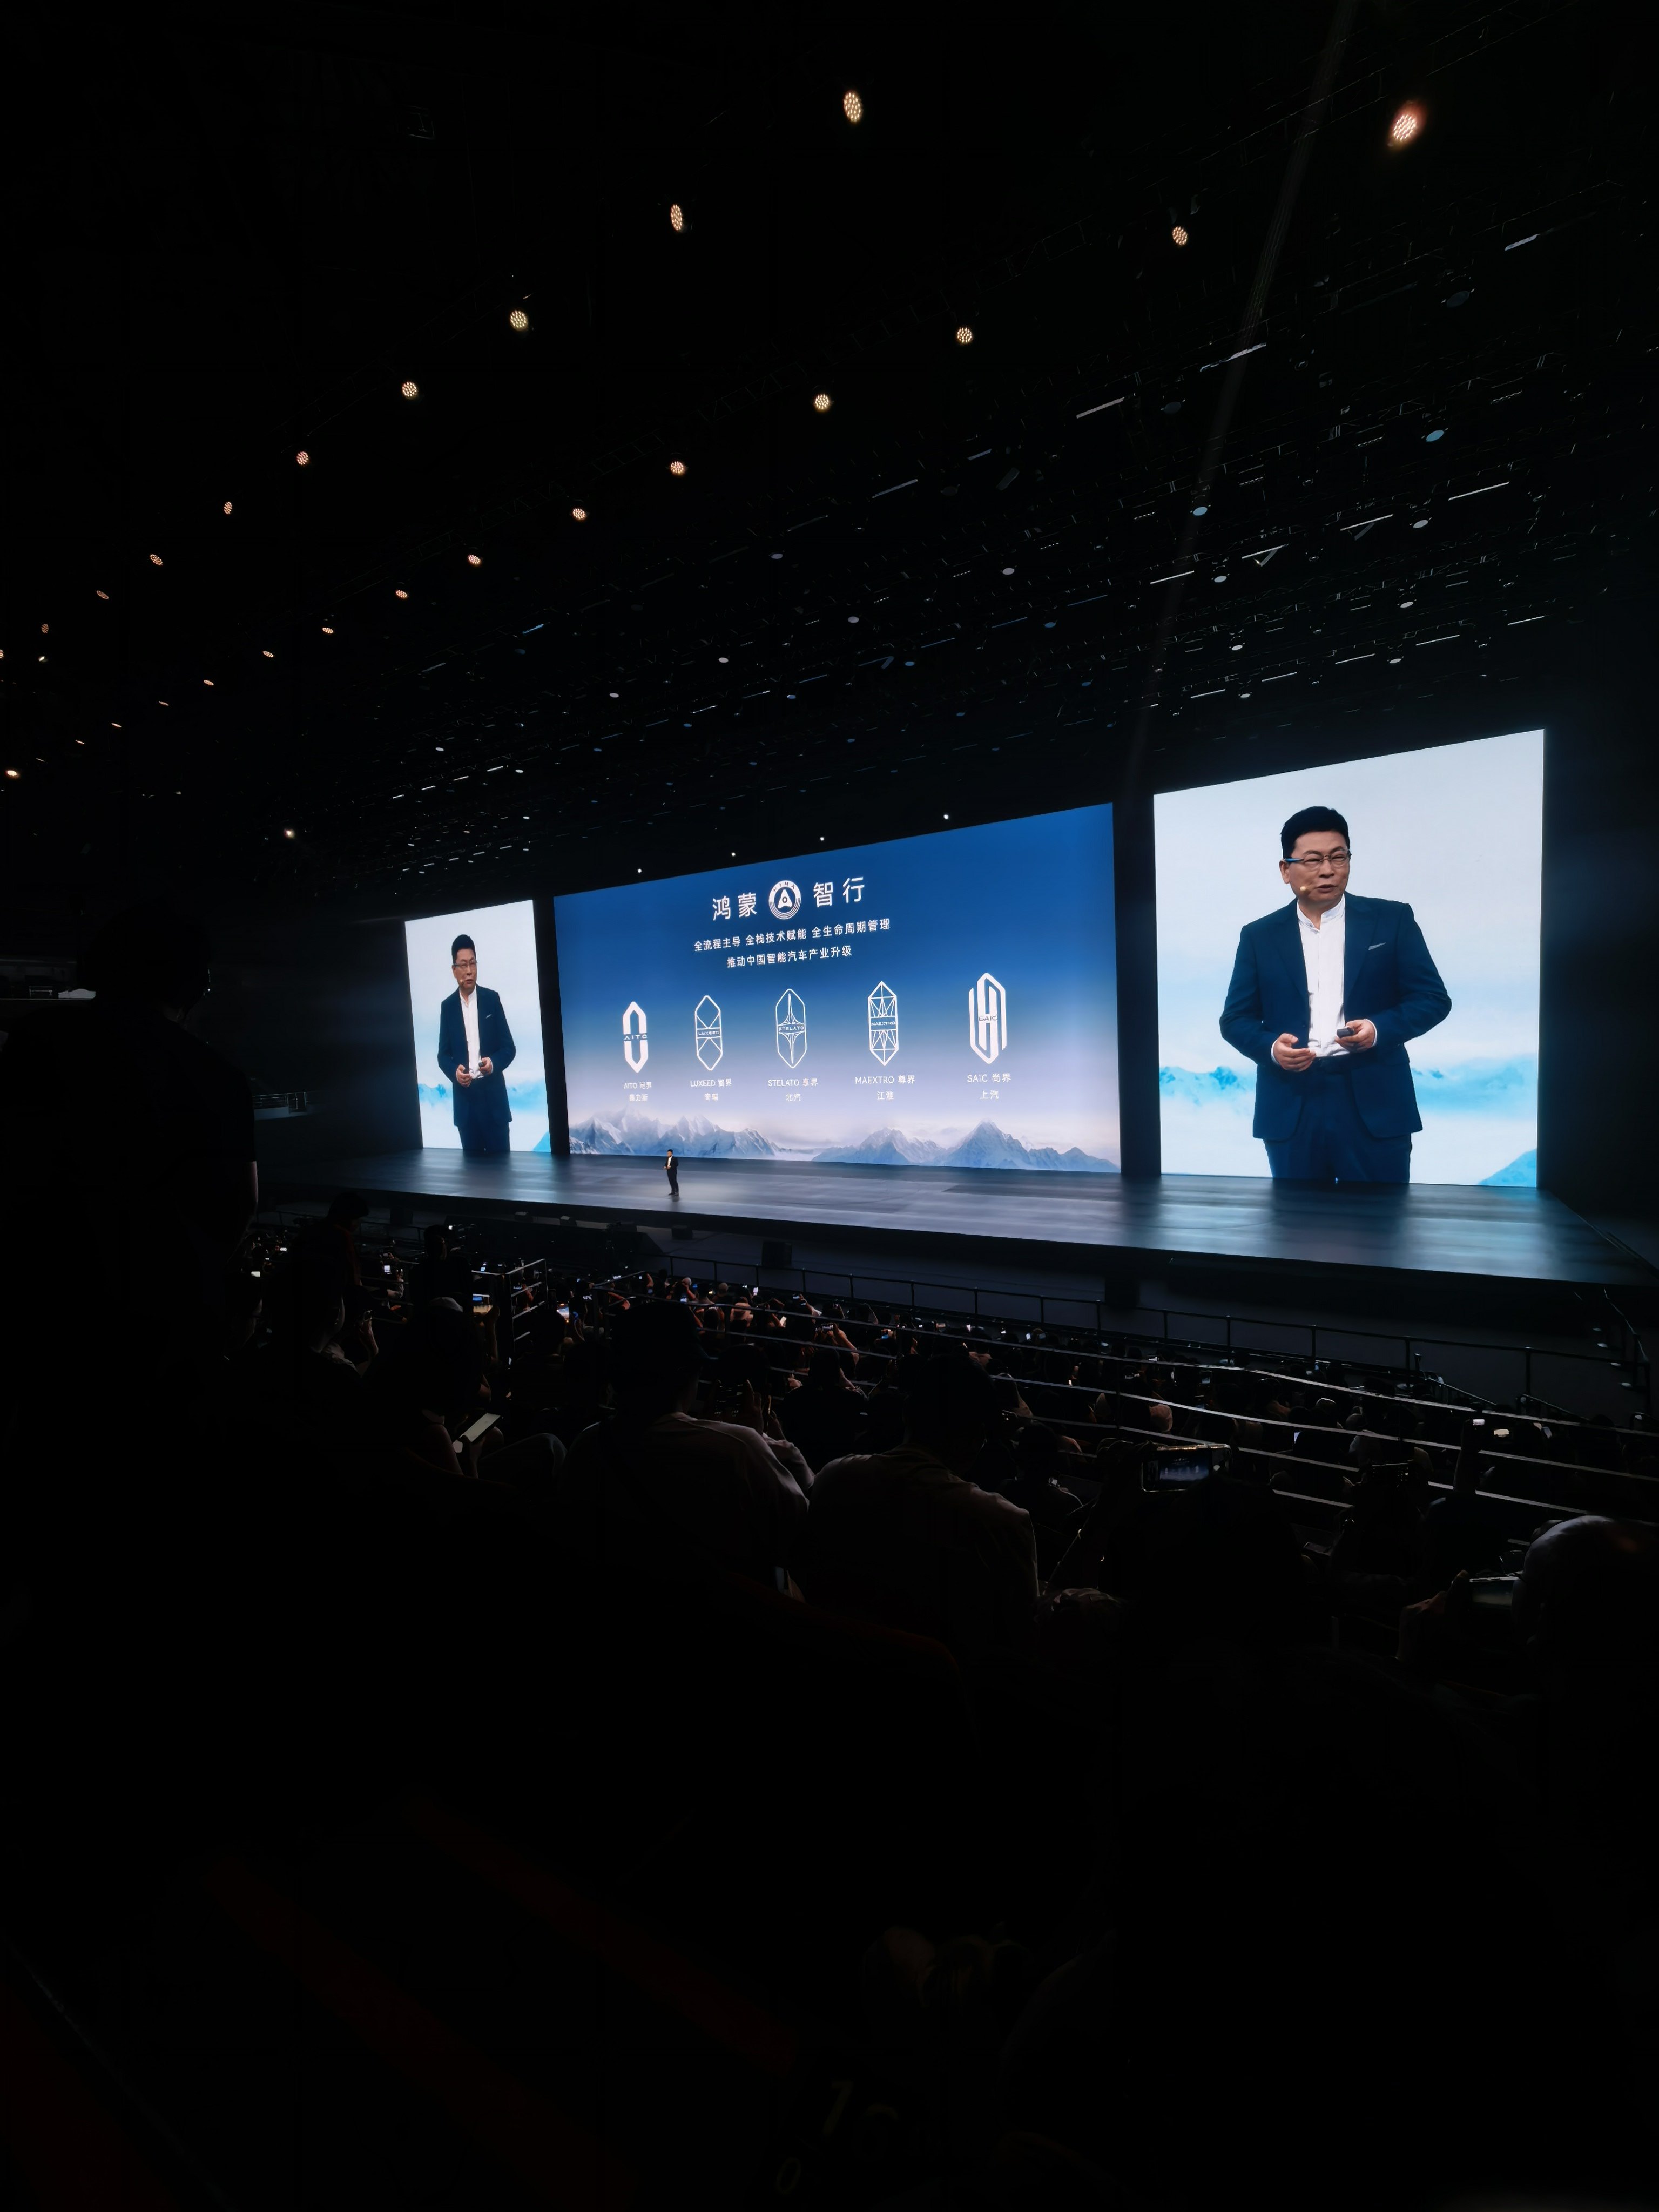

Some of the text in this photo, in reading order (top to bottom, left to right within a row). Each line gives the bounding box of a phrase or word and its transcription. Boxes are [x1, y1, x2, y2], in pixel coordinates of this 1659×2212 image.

[713, 877, 864, 920] 鸿蒙 智行
[694, 919, 889, 951] 全流程主导 全栈技术赋能 全生命周期管理
[726, 945, 852, 968] 推动中国智能汽车产业升级
[898, 1075, 915, 1083] 尊界
[967, 1073, 1011, 1082] SAIC 尚界
[718, 1078, 731, 1087] 智界
[786, 1093, 800, 1101] 北汽
[878, 1091, 894, 1100] 江淮
[980, 1090, 999, 1099] 上汽
